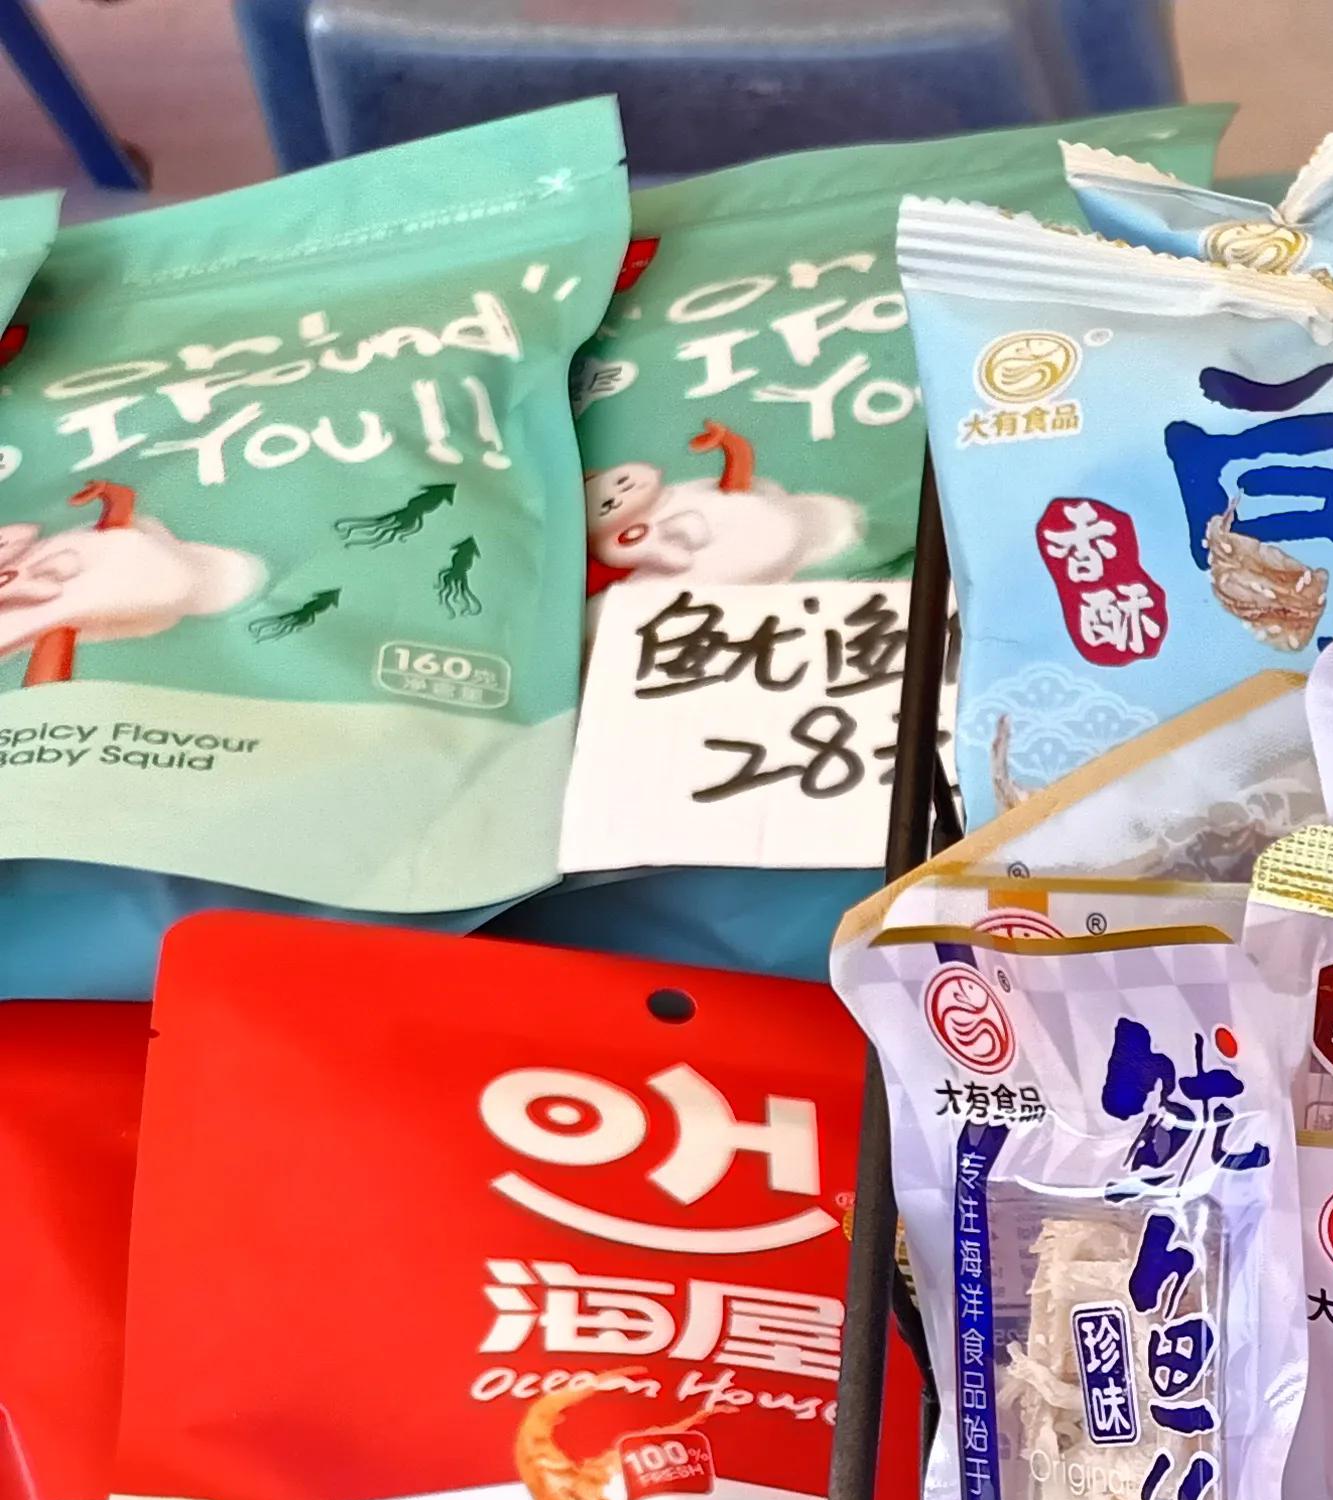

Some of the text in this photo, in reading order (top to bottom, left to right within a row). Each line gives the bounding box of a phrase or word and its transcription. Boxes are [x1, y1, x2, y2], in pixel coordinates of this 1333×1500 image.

[674, 291, 908, 400] I Fo
[55, 290, 523, 472] I Found
[750, 352, 922, 441] Yo
[960, 405, 1082, 444] 大有食品
[1044, 504, 1163, 658] 香酥
[635, 590, 962, 700] 鱿鱼
[0, 745, 215, 770] aby Squid
[112, 722, 262, 753] Flavour
[935, 1080, 1046, 1127] 大有食品
[478, 1257, 846, 1382] 海屋
[471, 1366, 661, 1401] Ocean
[1083, 1317, 1132, 1435] 珍味
[624, 1440, 712, 1473] 100%
[1029, 1450, 1132, 1494] Original
